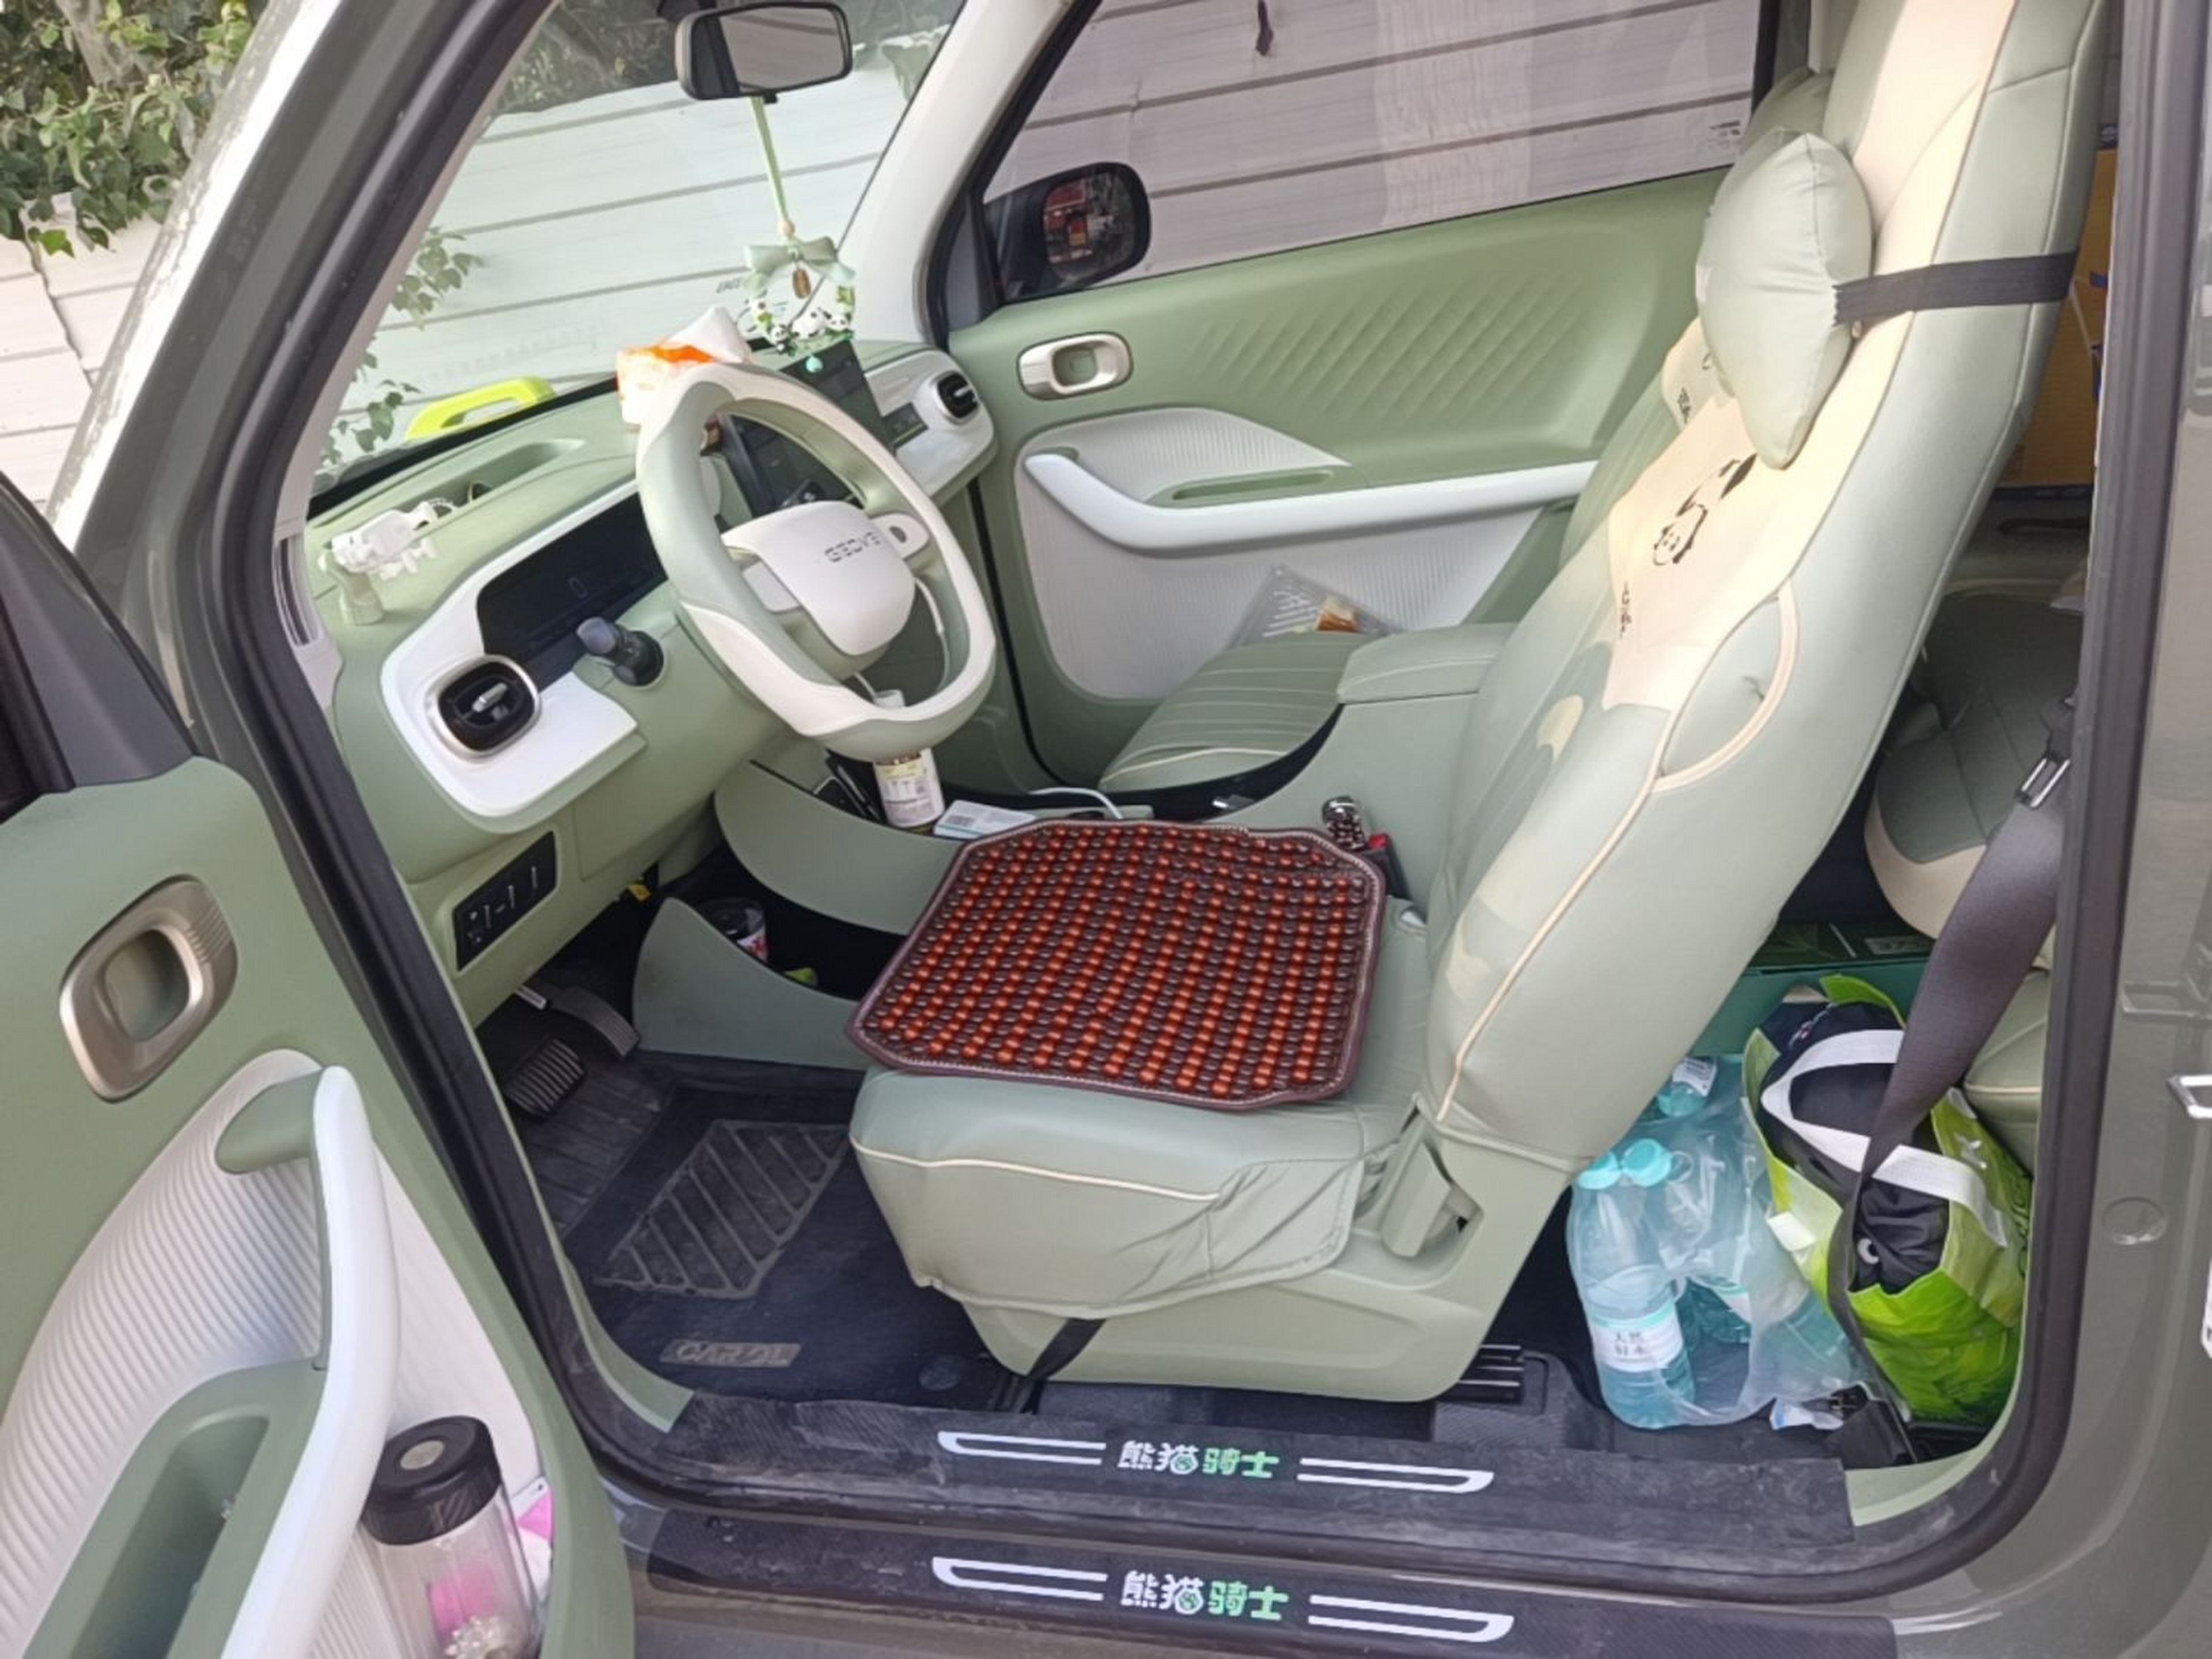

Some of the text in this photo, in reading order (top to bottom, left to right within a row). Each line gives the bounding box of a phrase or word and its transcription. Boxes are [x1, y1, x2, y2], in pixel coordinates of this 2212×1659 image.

[1117, 1440, 1279, 1479] 熊猫骑士
[1120, 1570, 1289, 1620] 熊猫骑士
